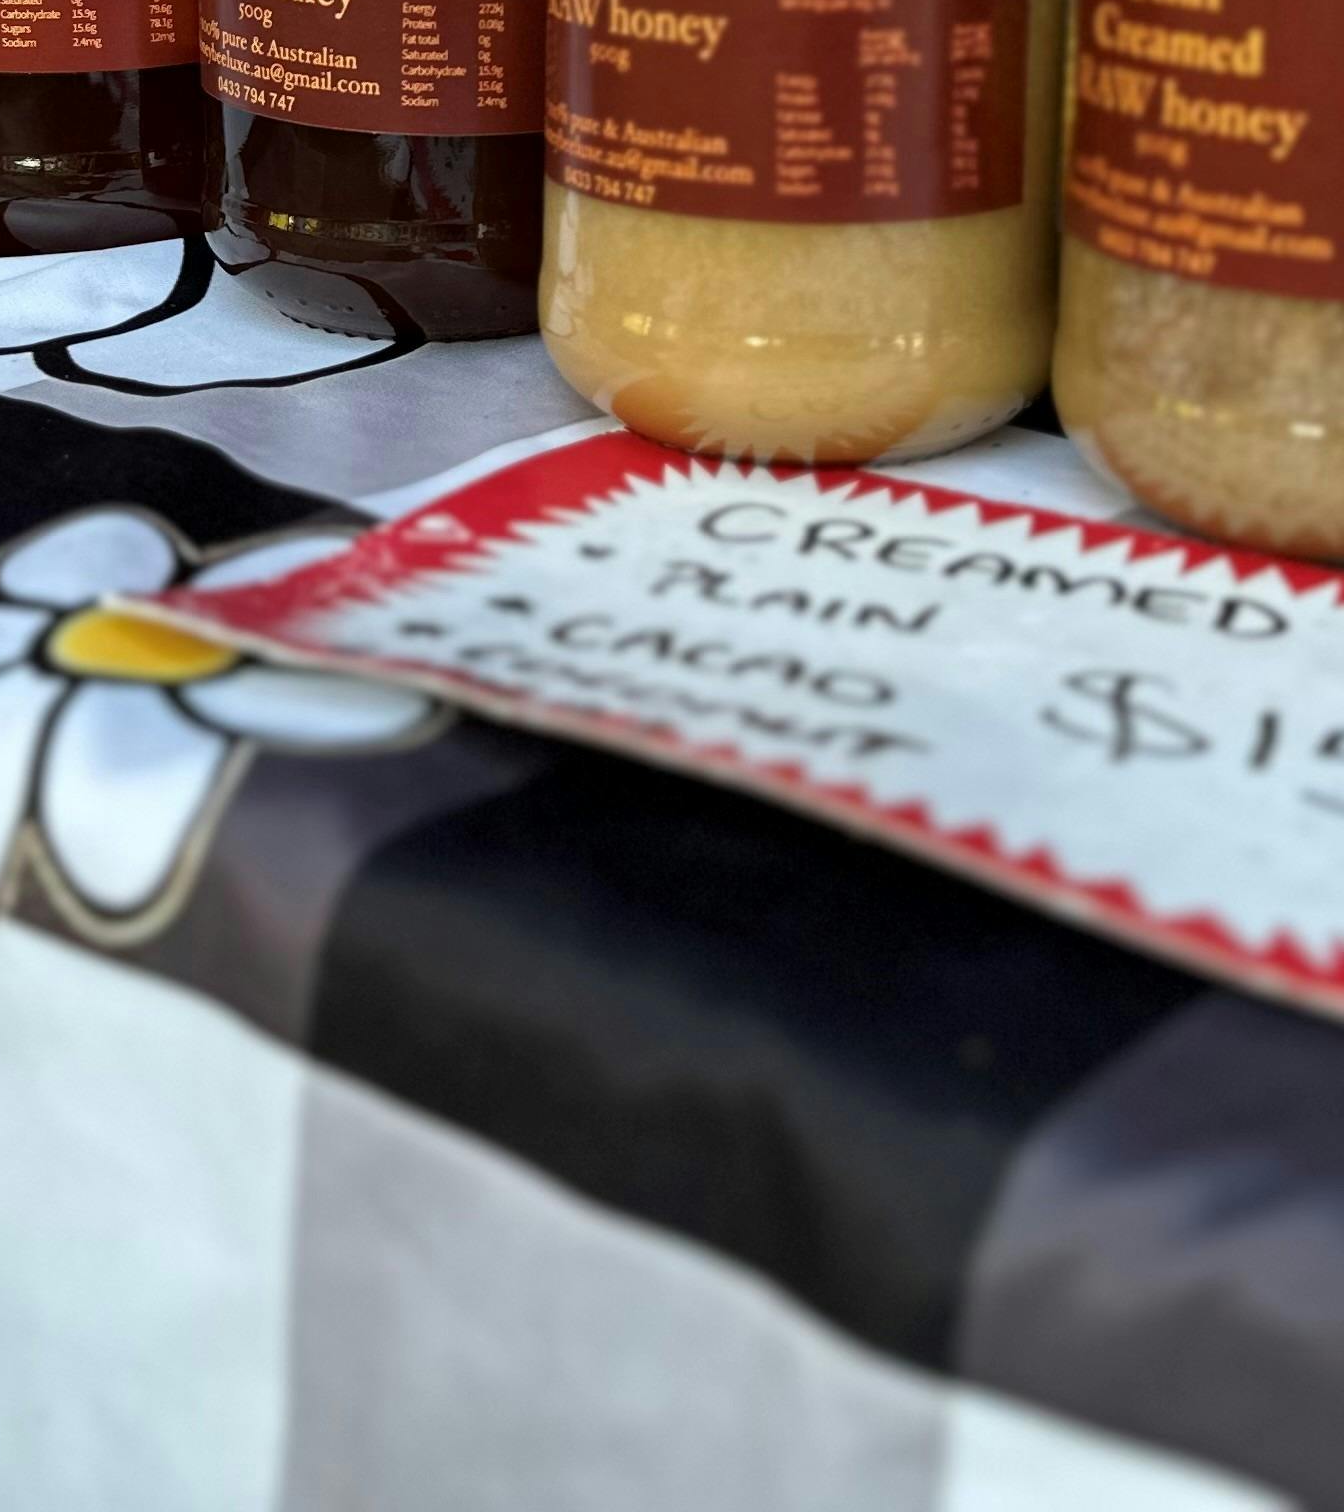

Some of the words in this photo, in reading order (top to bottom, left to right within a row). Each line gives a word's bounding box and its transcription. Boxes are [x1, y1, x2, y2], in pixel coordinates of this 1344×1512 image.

[0, 9, 61, 22] Carbohydrate
[72, 9, 96, 20] 15.9g
[149, 4, 172, 15] 79.6g
[239, 3, 273, 28] 500g
[1094, 1, 1265, 76] Creamed
[222, 31, 247, 50] pure
[251, 37, 263, 55] &
[267, 40, 357, 69] Australian
[218, 76, 240, 98] 0433
[244, 86, 265, 106] 794
[269, 92, 295, 112] 747
[1162, 77, 1308, 162] honey
[623, 120, 728, 155] Australian
[655, 559, 943, 639] PLAIN
[697, 500, 1294, 644] CREAMED
[548, 612, 898, 711] CACAO
